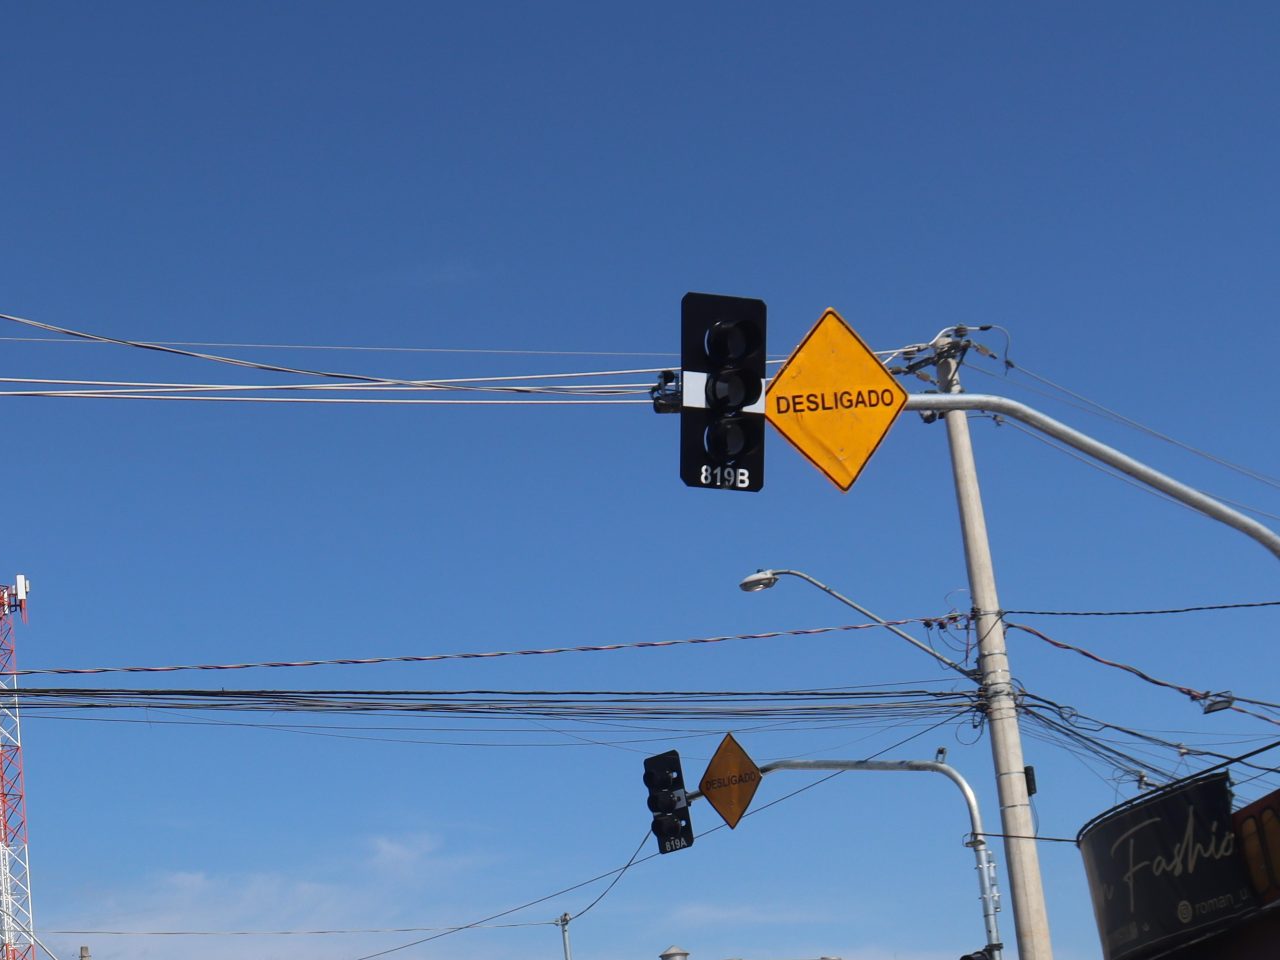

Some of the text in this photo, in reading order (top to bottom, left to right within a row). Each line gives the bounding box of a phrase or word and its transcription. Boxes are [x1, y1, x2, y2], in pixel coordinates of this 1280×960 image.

[775, 388, 895, 415] DESLIGADO
[700, 464, 750, 488] 819B
[705, 770, 756, 791] DESLIGADO
[665, 838, 688, 852] 819A
